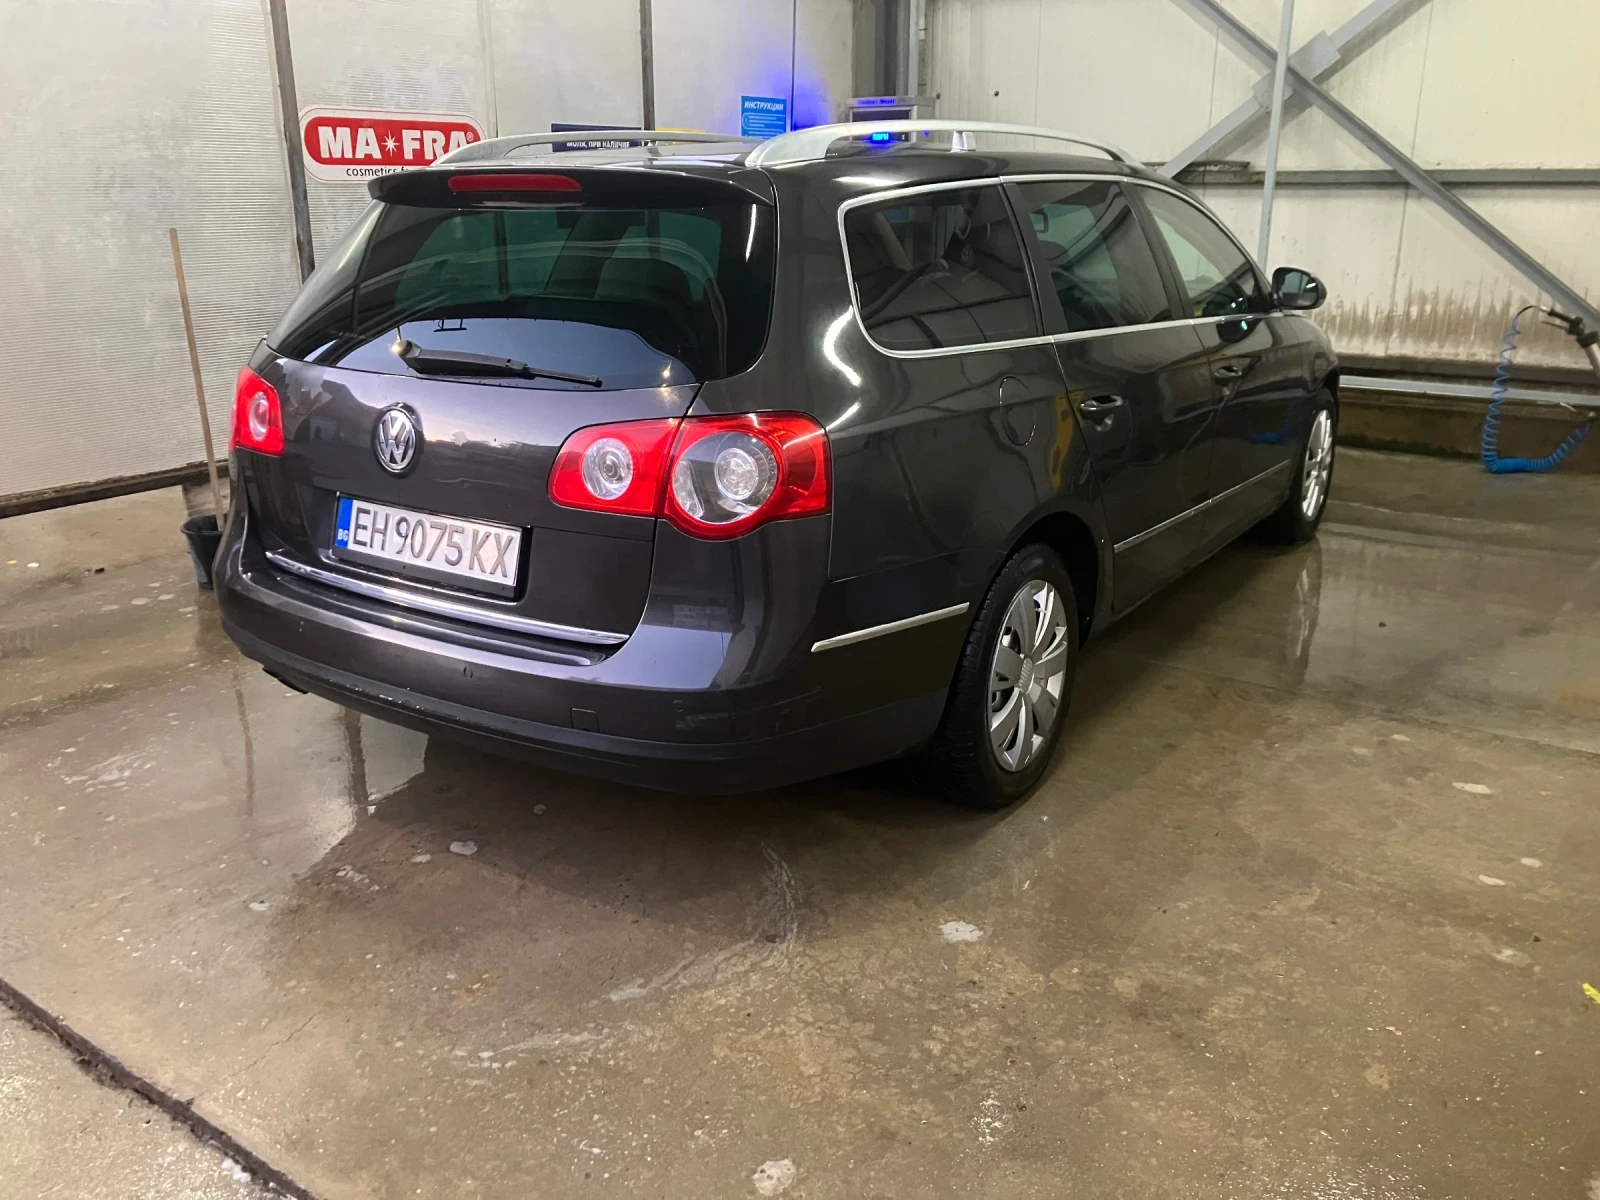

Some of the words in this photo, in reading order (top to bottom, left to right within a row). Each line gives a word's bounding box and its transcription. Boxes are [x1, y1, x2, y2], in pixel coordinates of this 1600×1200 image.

[744, 101, 784, 111] ИНСТРУКЦИИ
[318, 126, 382, 160] MA
[346, 167, 397, 177] cosmetics
[337, 529, 349, 541] BG
